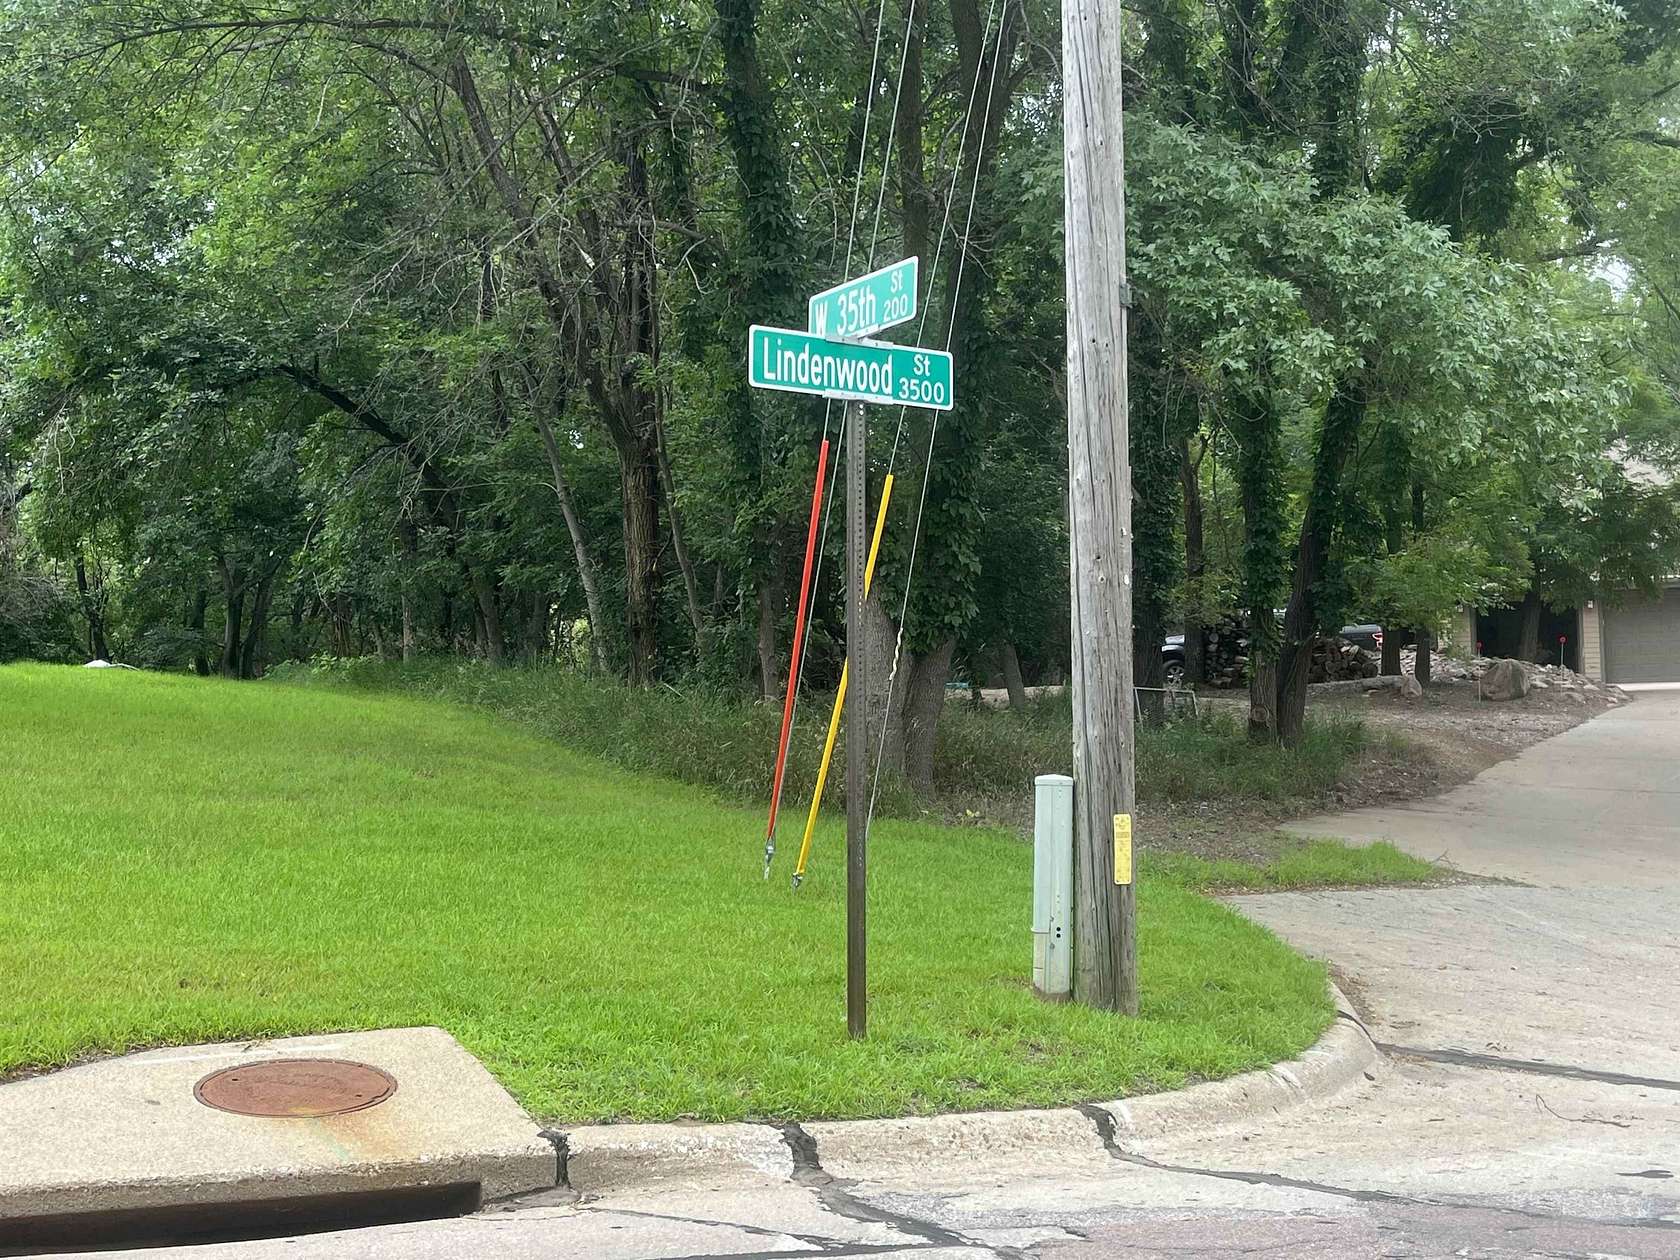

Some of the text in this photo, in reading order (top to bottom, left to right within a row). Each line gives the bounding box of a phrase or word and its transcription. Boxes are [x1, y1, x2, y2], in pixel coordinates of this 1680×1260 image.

[815, 270, 904, 337] W 35th St
[883, 294, 909, 322] 200
[763, 336, 931, 395] Lindenwood St
[899, 377, 945, 403] 3500
